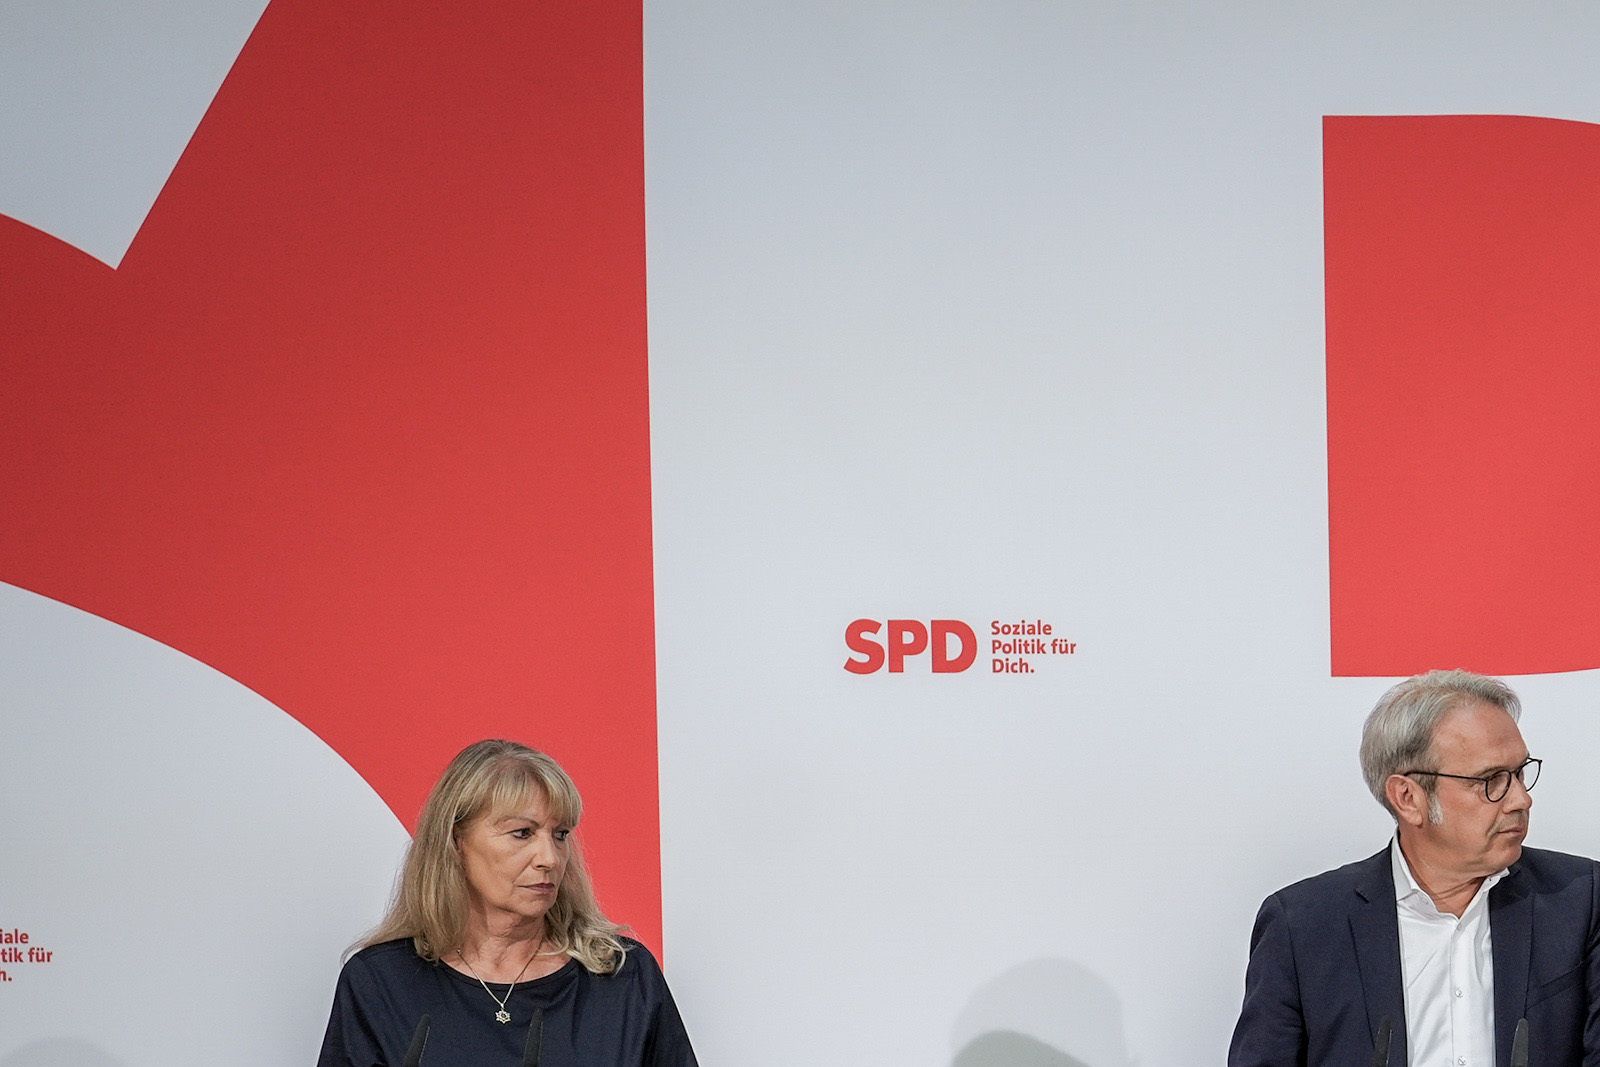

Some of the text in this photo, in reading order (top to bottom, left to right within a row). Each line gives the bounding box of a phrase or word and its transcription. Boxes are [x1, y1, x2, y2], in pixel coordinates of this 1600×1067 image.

[991, 619, 1053, 636] Soziale
[844, 618, 978, 675] SPD
[992, 637, 1077, 655] Politik für
[992, 657, 1035, 674] Dich.
[0, 928, 30, 944] iale
[28, 947, 53, 963] für
